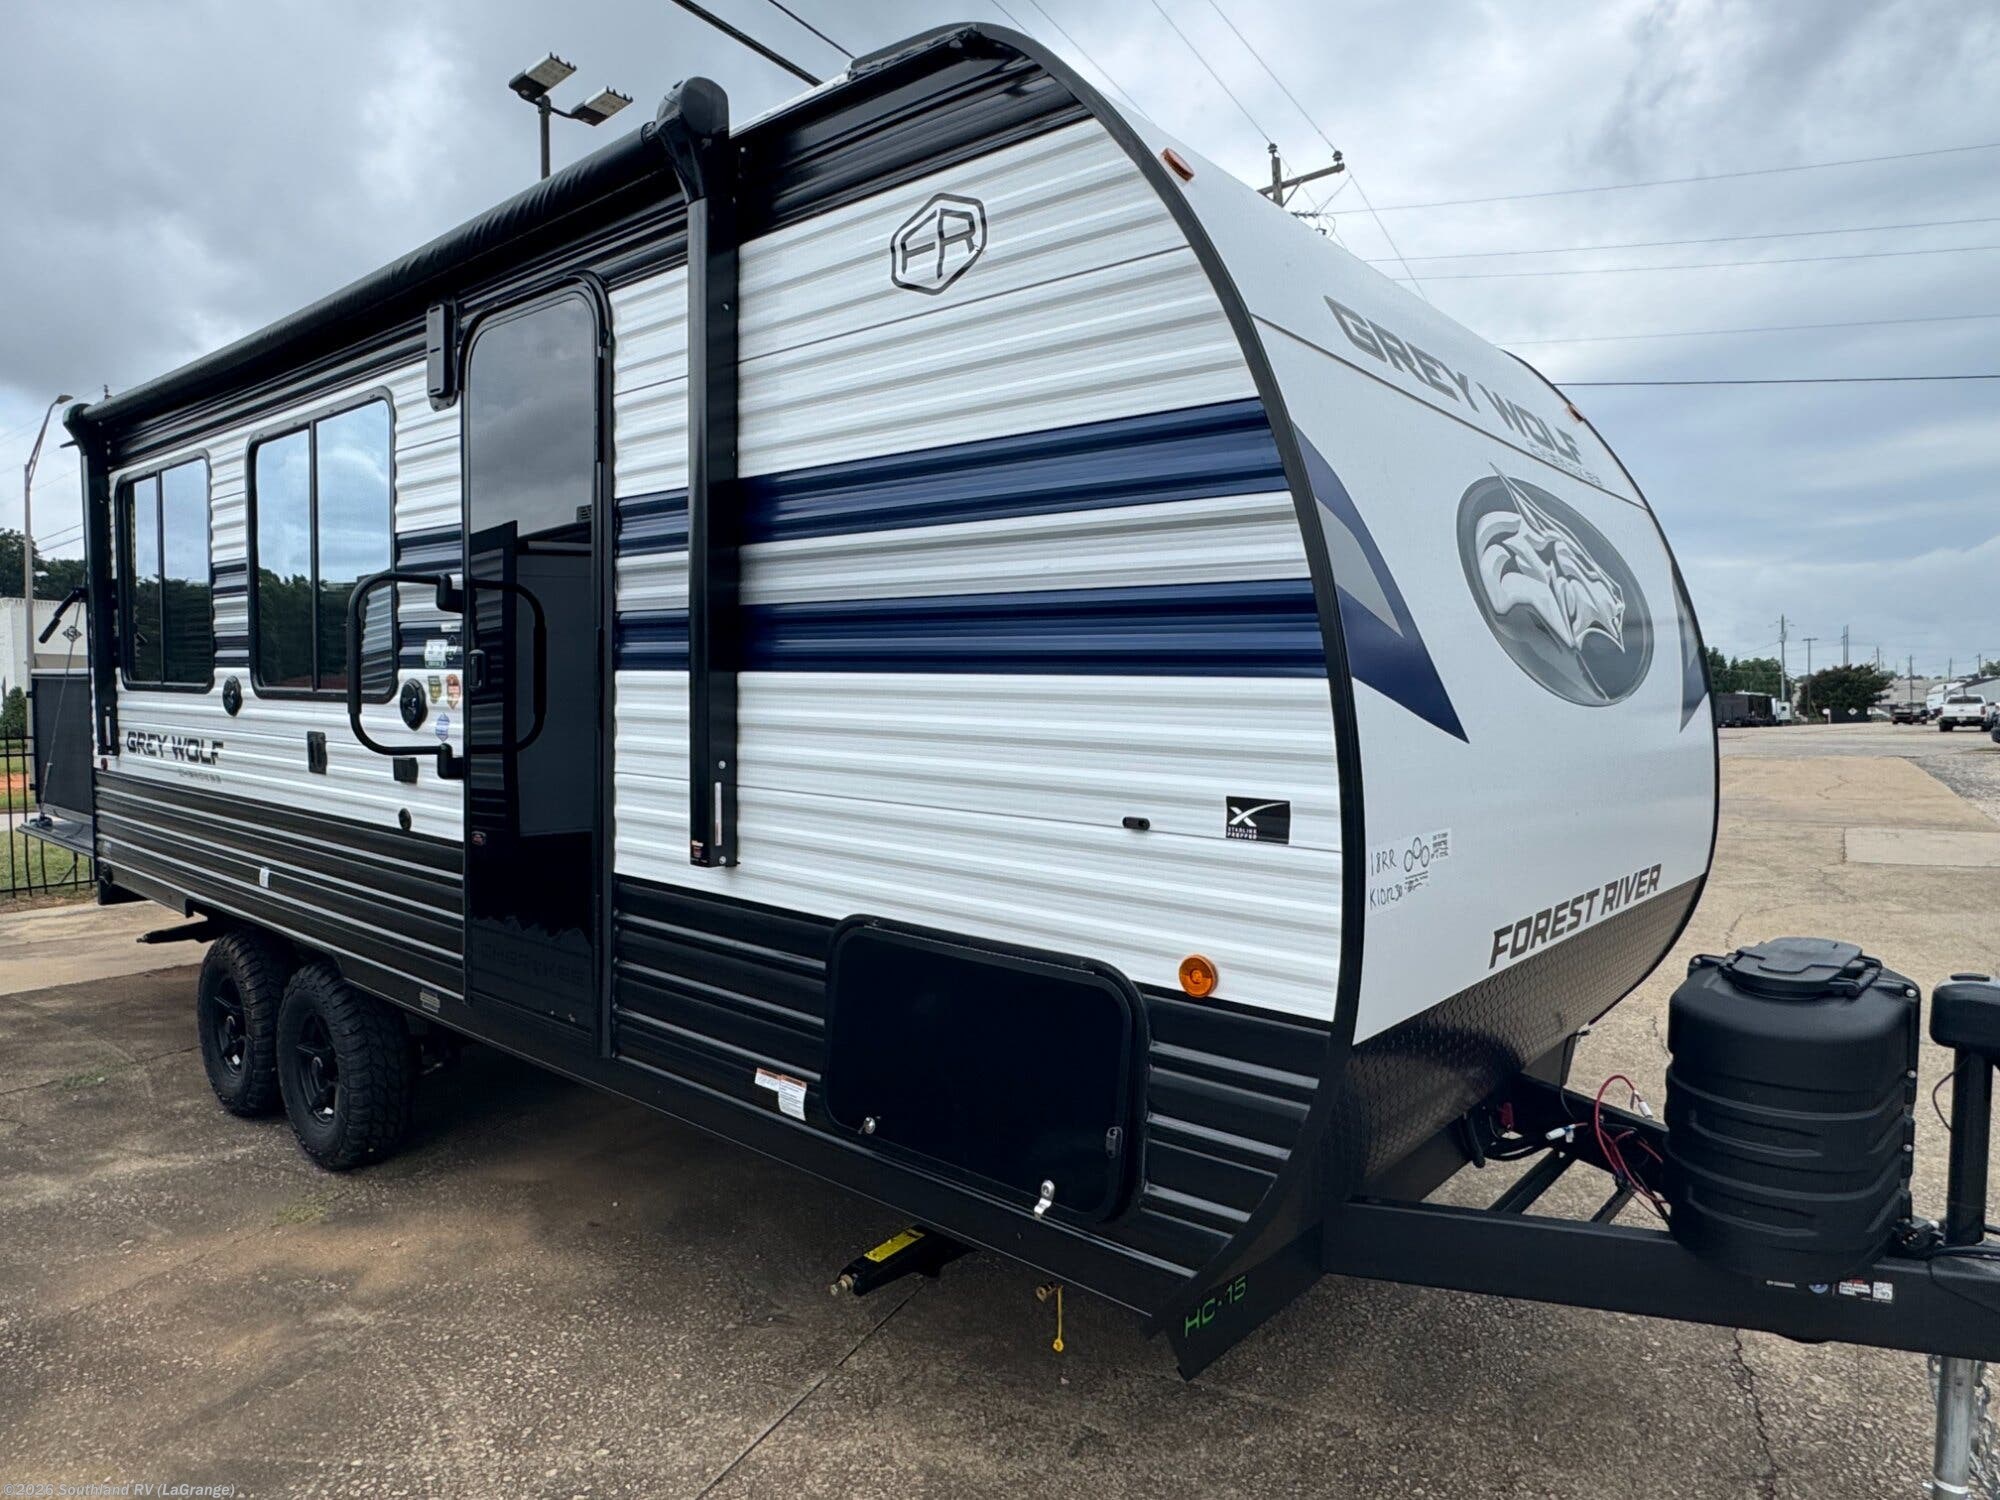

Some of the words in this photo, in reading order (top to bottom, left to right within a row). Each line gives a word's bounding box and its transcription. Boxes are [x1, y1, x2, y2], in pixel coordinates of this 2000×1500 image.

[1323, 294, 1480, 413] GREY
[1475, 380, 1583, 465] WOLF
[126, 730, 168, 758] GREY
[171, 735, 224, 766] WOLF
[1488, 887, 1601, 970] FOREST
[1600, 863, 1662, 916] RIVER
